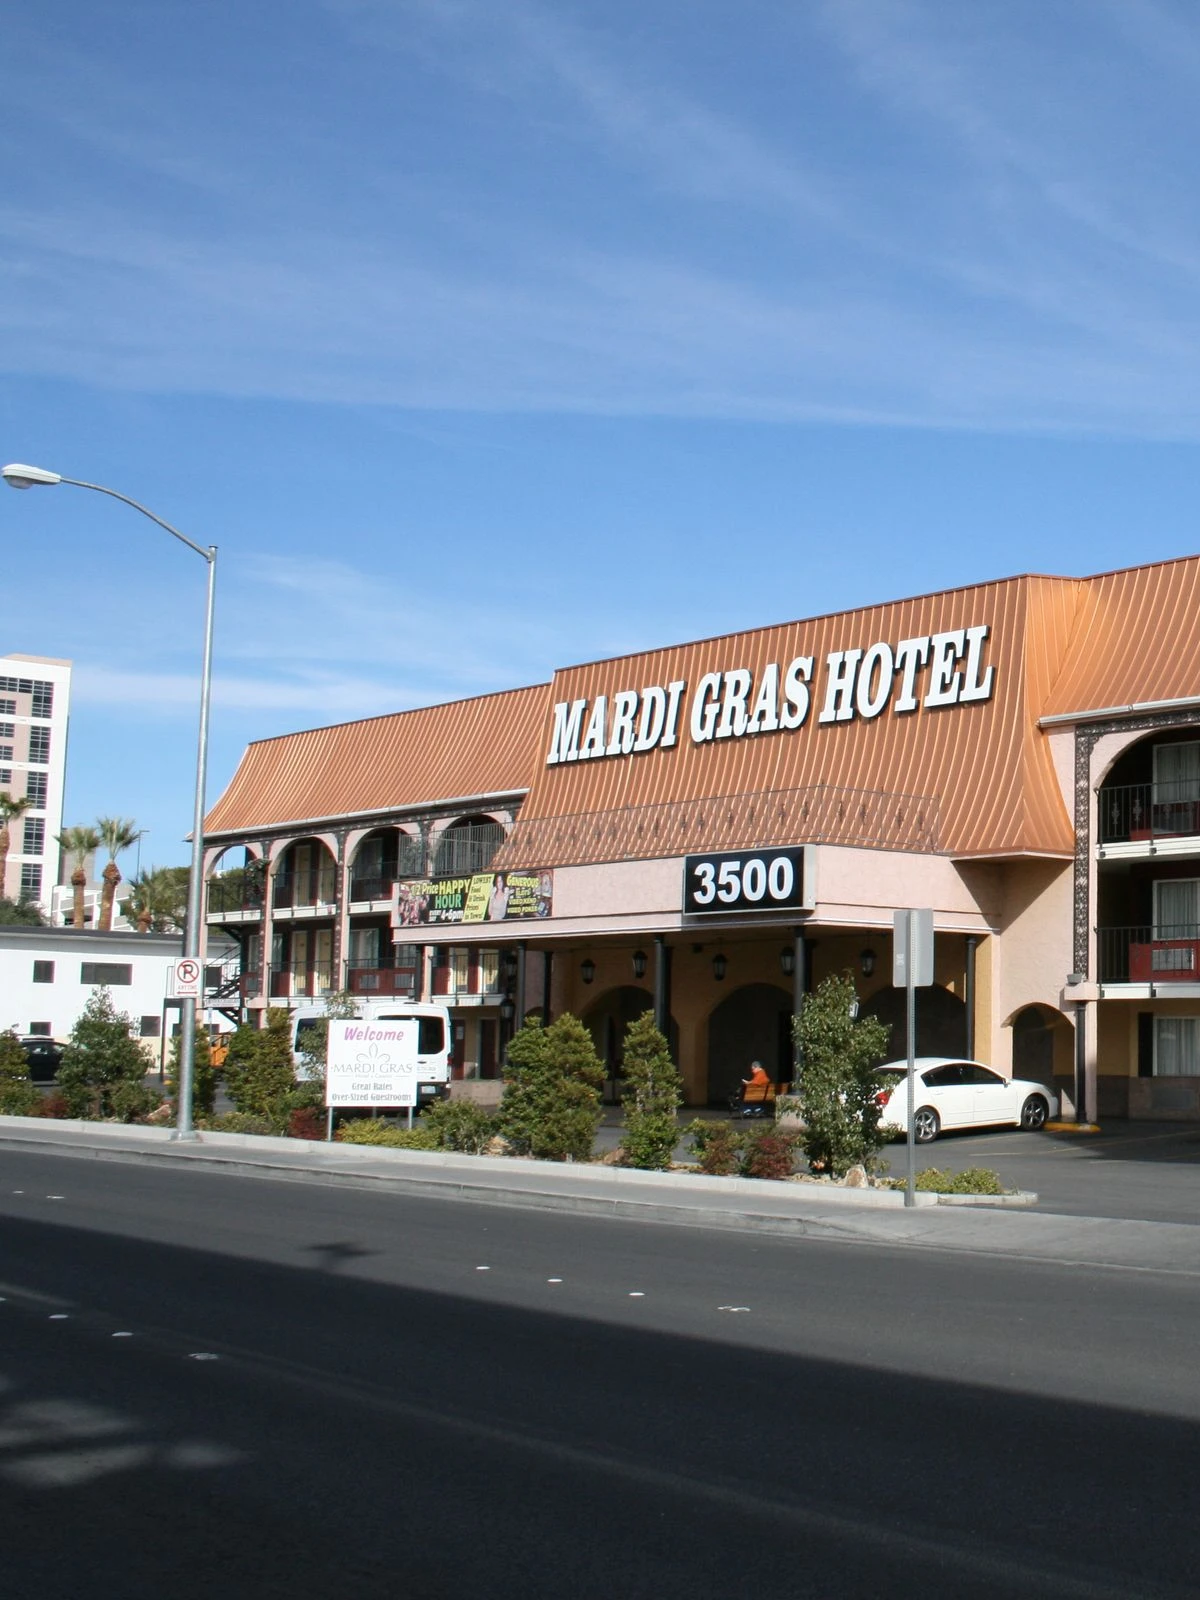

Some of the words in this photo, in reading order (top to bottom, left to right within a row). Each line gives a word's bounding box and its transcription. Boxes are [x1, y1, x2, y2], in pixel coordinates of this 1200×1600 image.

[546, 680, 686, 764] MARDI
[690, 656, 815, 743] GRAS
[818, 625, 995, 724] HOTEL
[422, 881, 439, 895] Price
[439, 879, 471, 896] HAPPY
[693, 857, 794, 904] 3500
[435, 894, 462, 909] HOUR
[441, 909, 464, 922] 4-6pm
[344, 1026, 404, 1041] Welcome
[333, 1063, 375, 1073] MARDI
[379, 1063, 413, 1073] GRAS
[352, 1082, 371, 1091] Great
[373, 1082, 393, 1091] Rates
[331, 1093, 369, 1101] Over-Sized
[370, 1093, 412, 1102] Guestrooms
